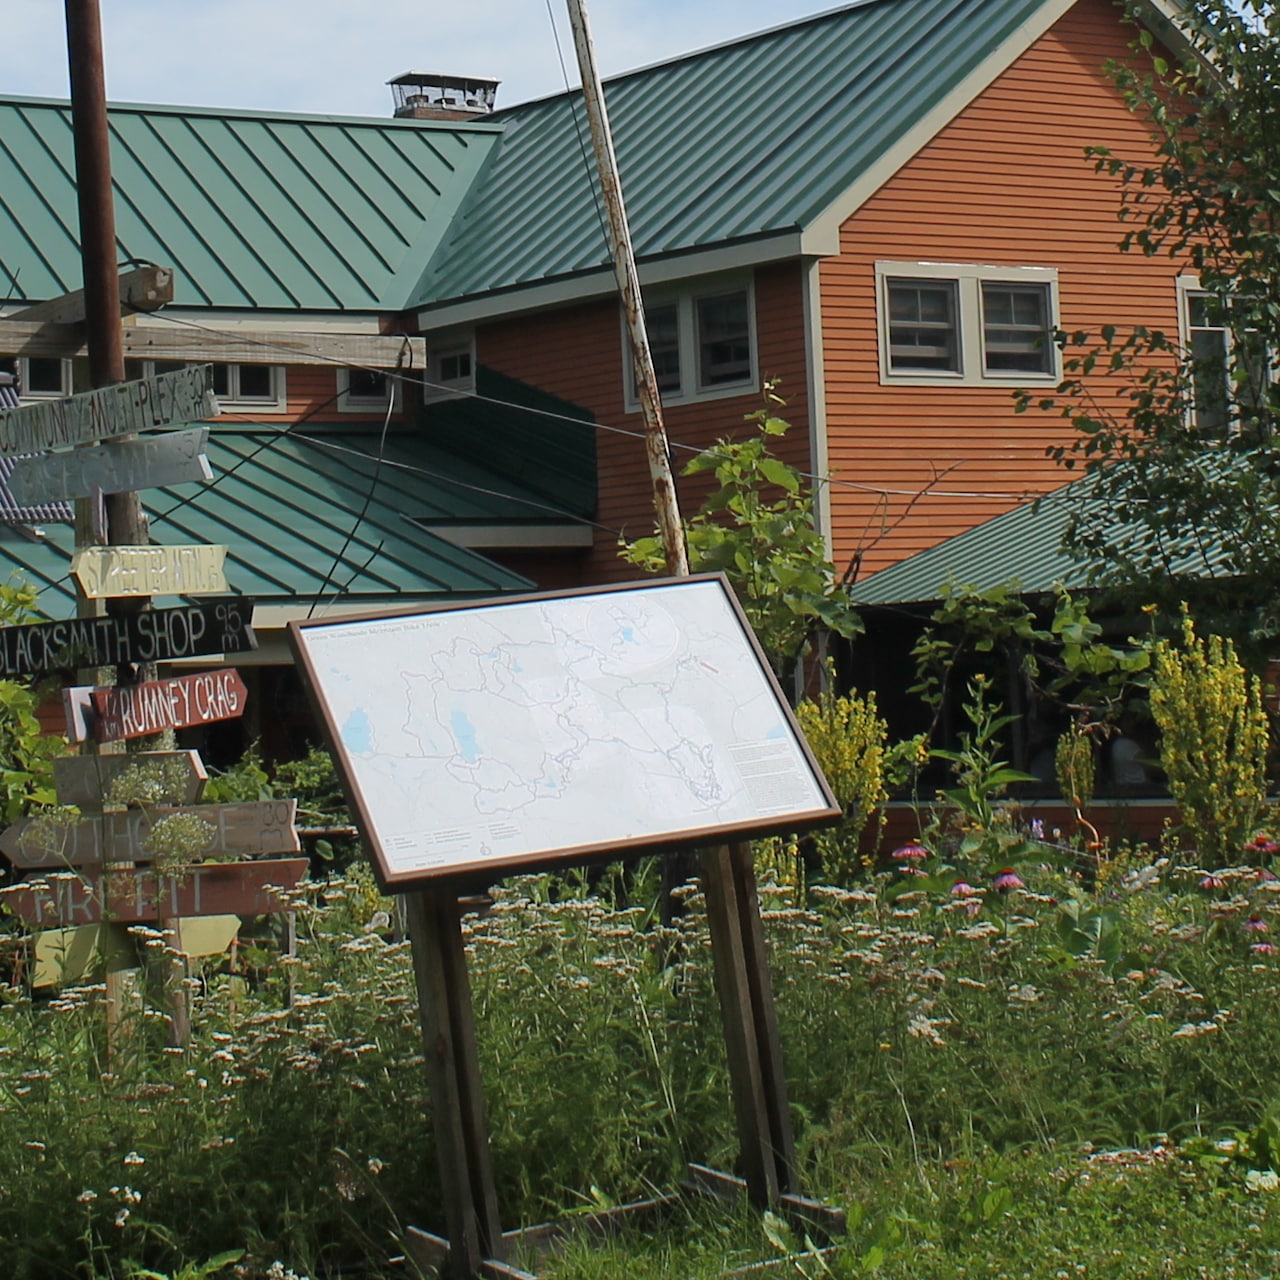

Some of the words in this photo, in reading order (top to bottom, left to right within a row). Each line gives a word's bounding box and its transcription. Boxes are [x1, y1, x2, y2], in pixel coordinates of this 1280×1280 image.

[137, 608, 206, 658] SHOP
[215, 603, 241, 632] 95
[221, 632, 239, 650] m
[120, 680, 190, 736] RUMNEY
[195, 673, 238, 720] CRAG
